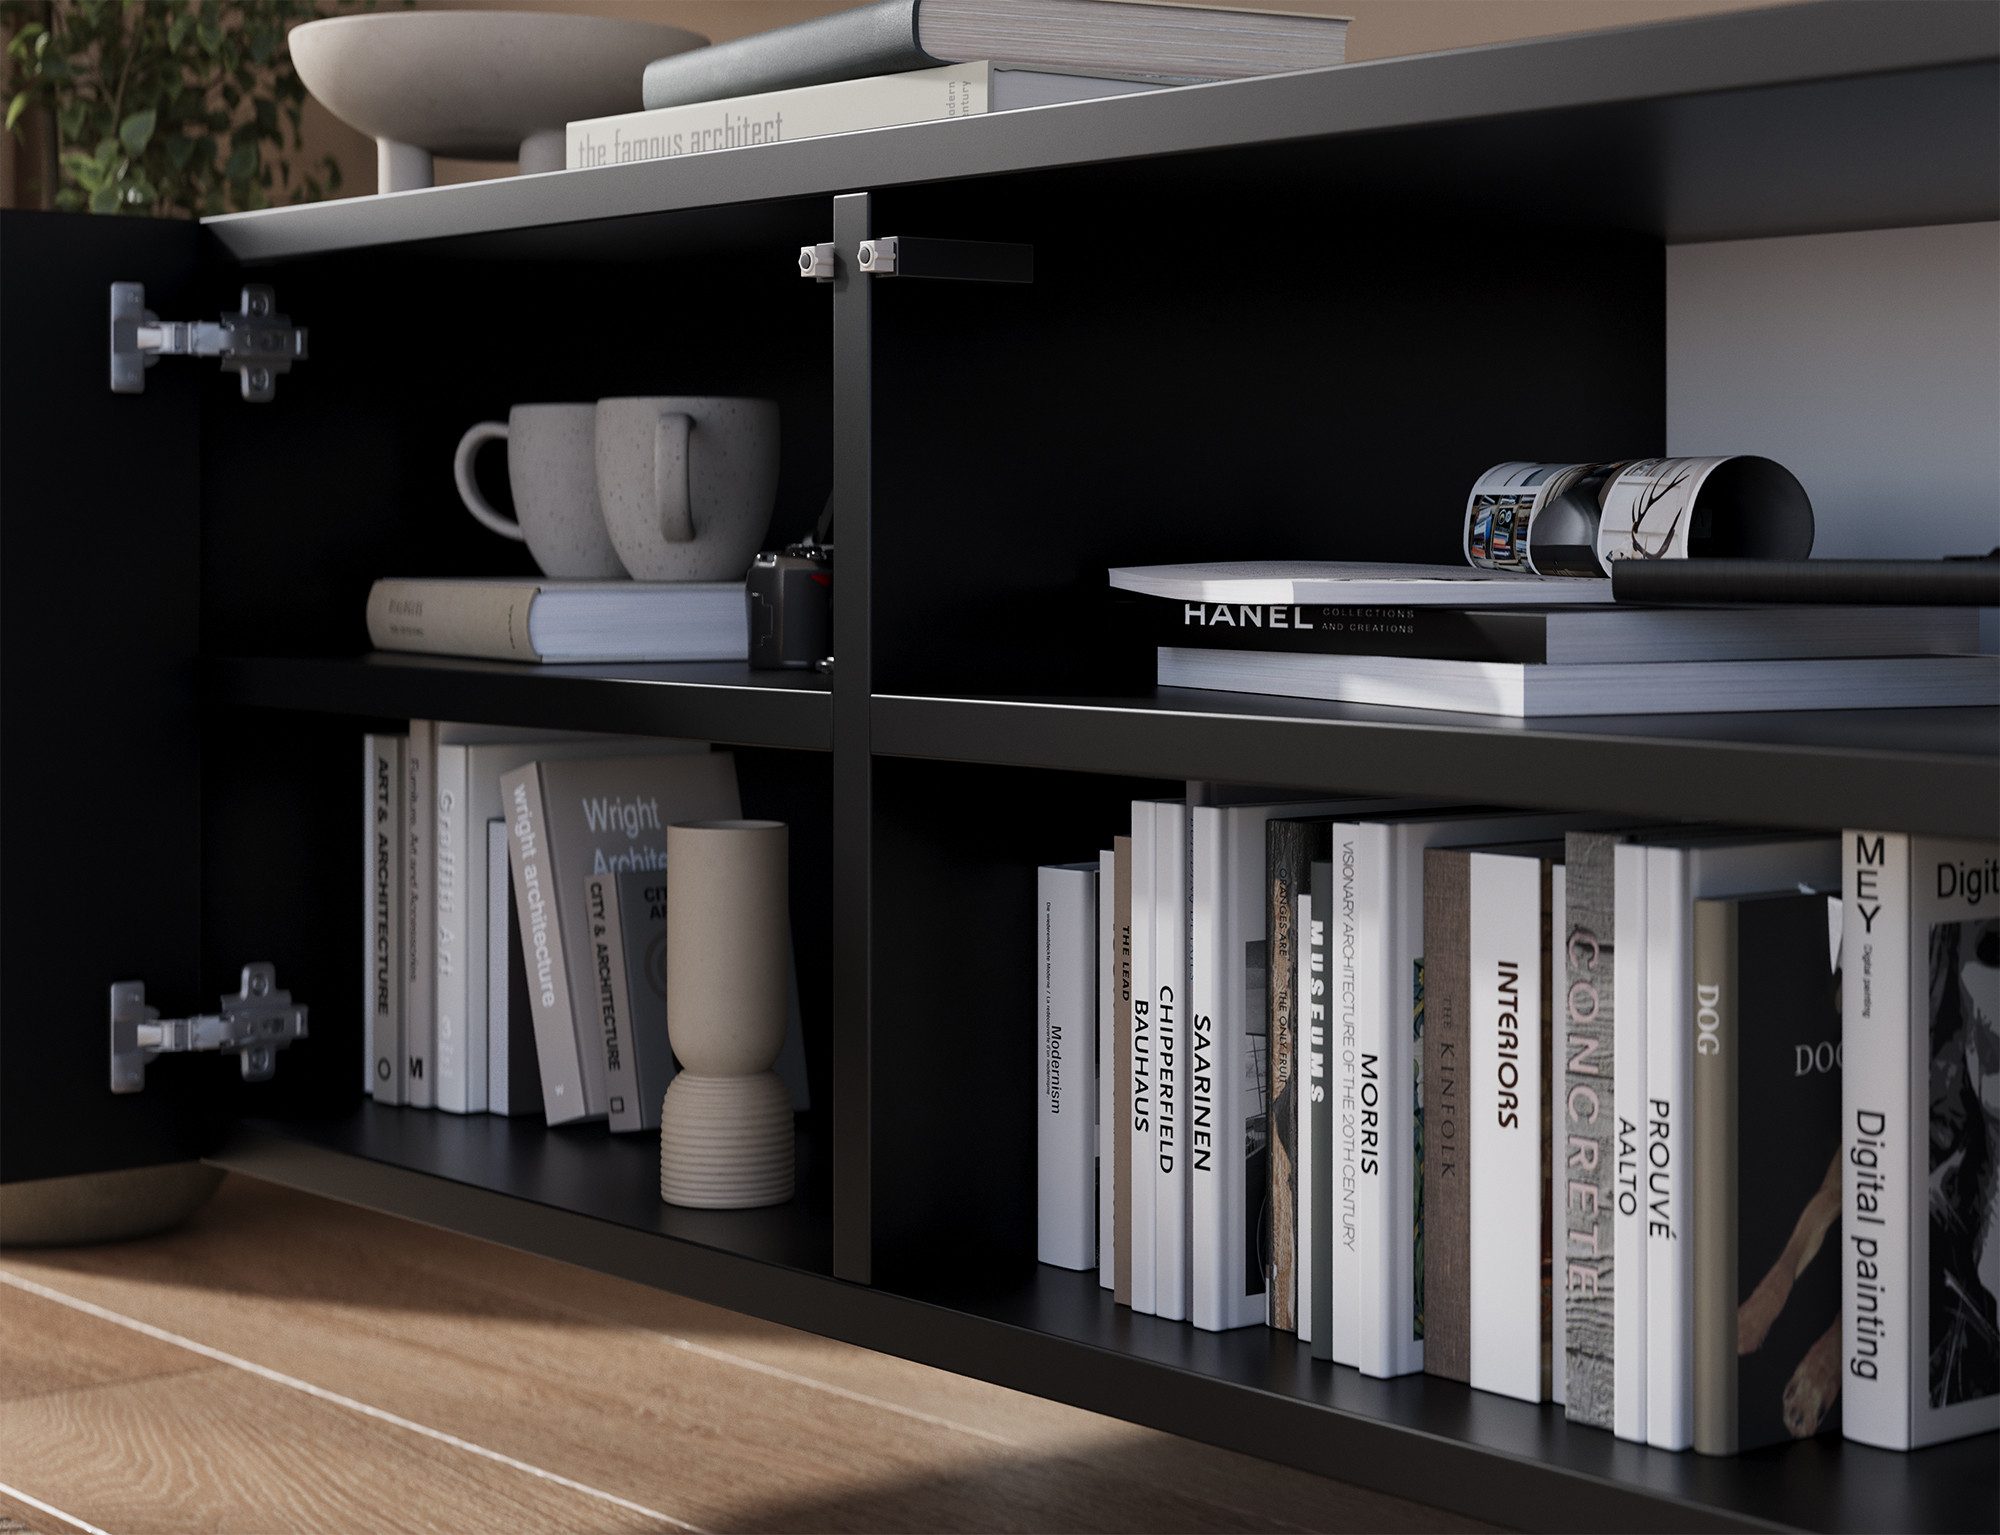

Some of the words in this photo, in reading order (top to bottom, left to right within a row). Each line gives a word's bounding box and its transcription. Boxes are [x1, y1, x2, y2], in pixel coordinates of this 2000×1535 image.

[945, 81, 956, 117] odern
[578, 132, 607, 168] the
[614, 128, 684, 164] famous
[691, 111, 783, 153] architect
[1322, 607, 1415, 619] COLLECTIONS
[1322, 622, 1344, 631] AND
[1350, 623, 1414, 634] CREATIONS
[377, 757, 389, 804] ART
[582, 797, 661, 839] Wright
[513, 783, 538, 860] wright
[590, 882, 605, 920] CITY
[1278, 867, 1288, 929] ORANGES
[1342, 840, 1355, 922] VISIONARY
[376, 832, 389, 1015] ARCHITECTURE
[523, 864, 556, 1008] architecture
[1120, 925, 1131, 956] THE
[1278, 932, 1288, 957] ARE
[596, 943, 621, 1071] ARCHITECTURE
[1120, 960, 1132, 1002] LEAD
[1278, 990, 1288, 1012] THE
[1309, 920, 1325, 1105] MUSEUMS
[1342, 922, 1355, 1047] ARCHITECTURE
[1442, 994, 1452, 1030] THE
[1697, 983, 1720, 1056] DOG
[1051, 1025, 1062, 1114] Modernism
[1133, 999, 1150, 1134] BAUHAUS
[1278, 1016, 1288, 1049] ONLY
[1278, 1052, 1288, 1085] FRUIT
[1342, 1049, 1355, 1074] OF
[1497, 961, 1519, 1129] INTERIORS
[1158, 984, 1175, 1175] CHIPPERFIELD
[1193, 1014, 1212, 1172] SAARINEN
[1342, 1076, 1355, 1111] THE
[1360, 1053, 1379, 1177] MORRIS
[1441, 1042, 1456, 1178] KINFOLK
[1567, 931, 1599, 1297] CONCRETE
[1618, 1116, 1638, 1218] AALTO
[1649, 1098, 1678, 1241] PROUVÉ
[1850, 1109, 1887, 1227] Digital
[1342, 1164, 1355, 1252] CENTURY
[1850, 1236, 1886, 1382] painting
